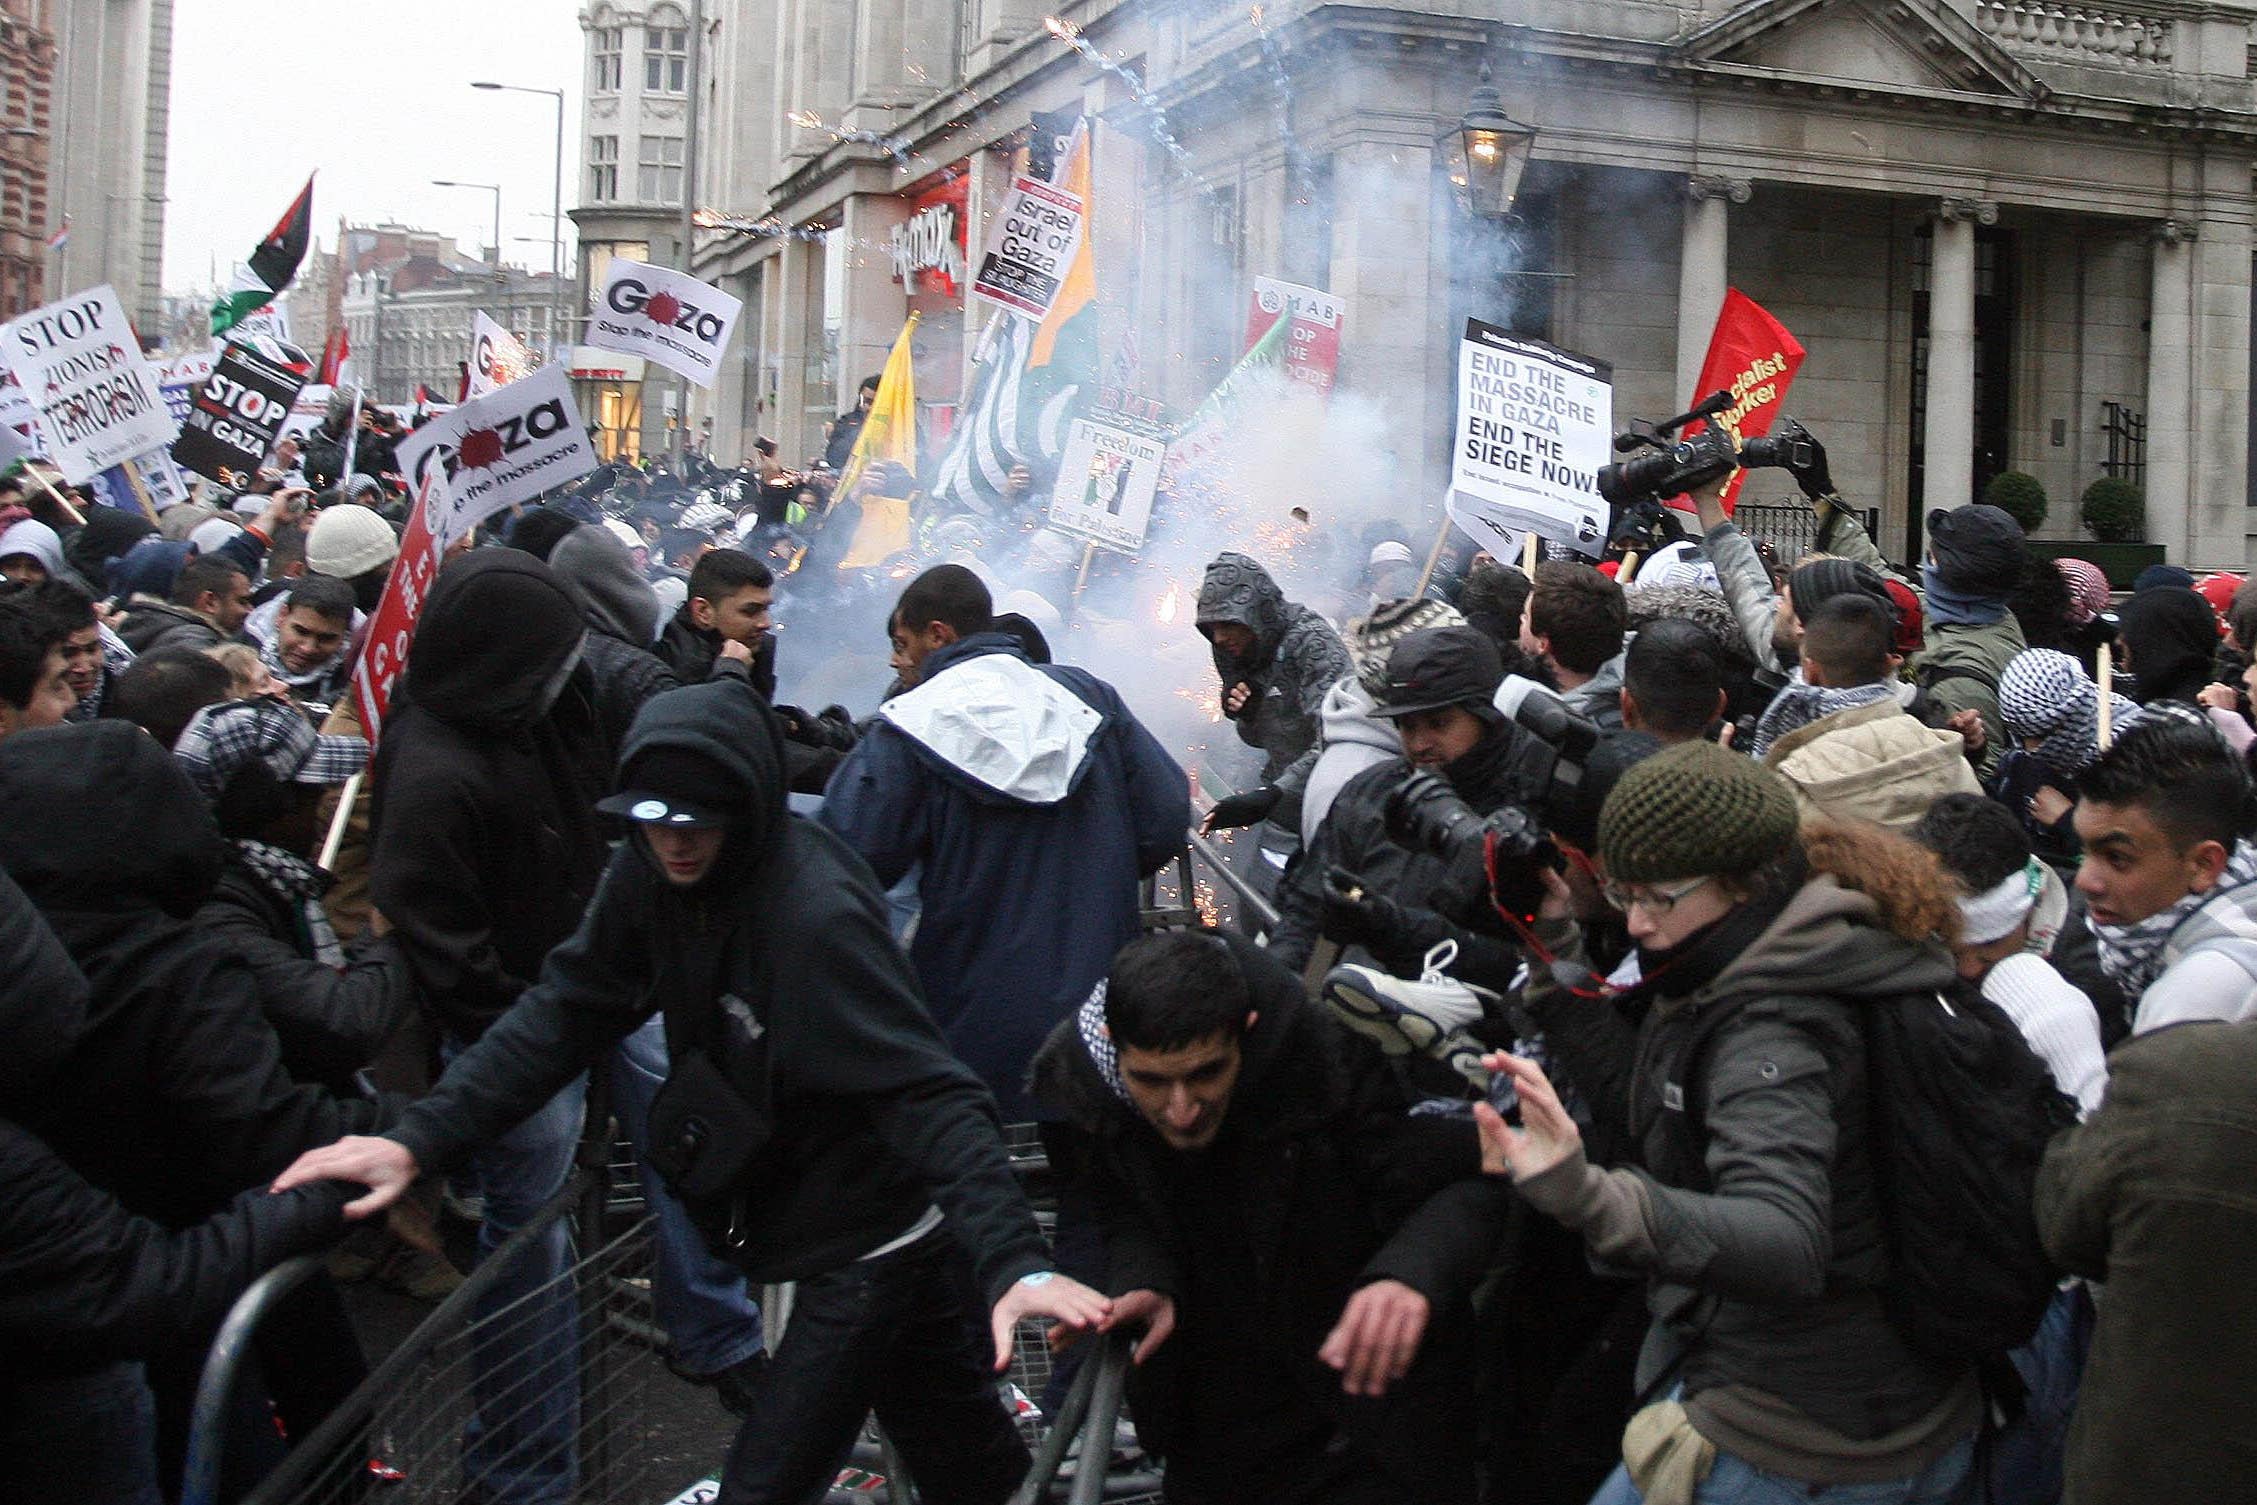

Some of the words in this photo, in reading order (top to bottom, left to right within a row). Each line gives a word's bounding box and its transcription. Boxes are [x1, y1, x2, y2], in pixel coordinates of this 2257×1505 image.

[1005, 217, 1041, 244] out
[1047, 233, 1074, 254] of
[1015, 194, 1077, 233] Israel
[1002, 236, 1057, 273] Gaza
[17, 300, 103, 357] STOP
[608, 279, 724, 346] Gza
[1292, 326, 1316, 342] OP
[1471, 351, 1517, 378] END
[1524, 364, 1566, 395] THE
[1729, 351, 1787, 400] cialist
[41, 369, 153, 447] TERRORISM
[204, 374, 287, 427] STOP
[1469, 392, 1492, 414] IN
[1502, 402, 1561, 436] GAZA
[1470, 372, 1596, 425] MASSACRE
[211, 420, 266, 460] GAZA
[1080, 423, 1155, 460] Freedom
[1465, 439, 1534, 475] SIEGE
[1468, 415, 1514, 445] END
[1521, 431, 1564, 461] THE
[496, 442, 579, 488] massacre
